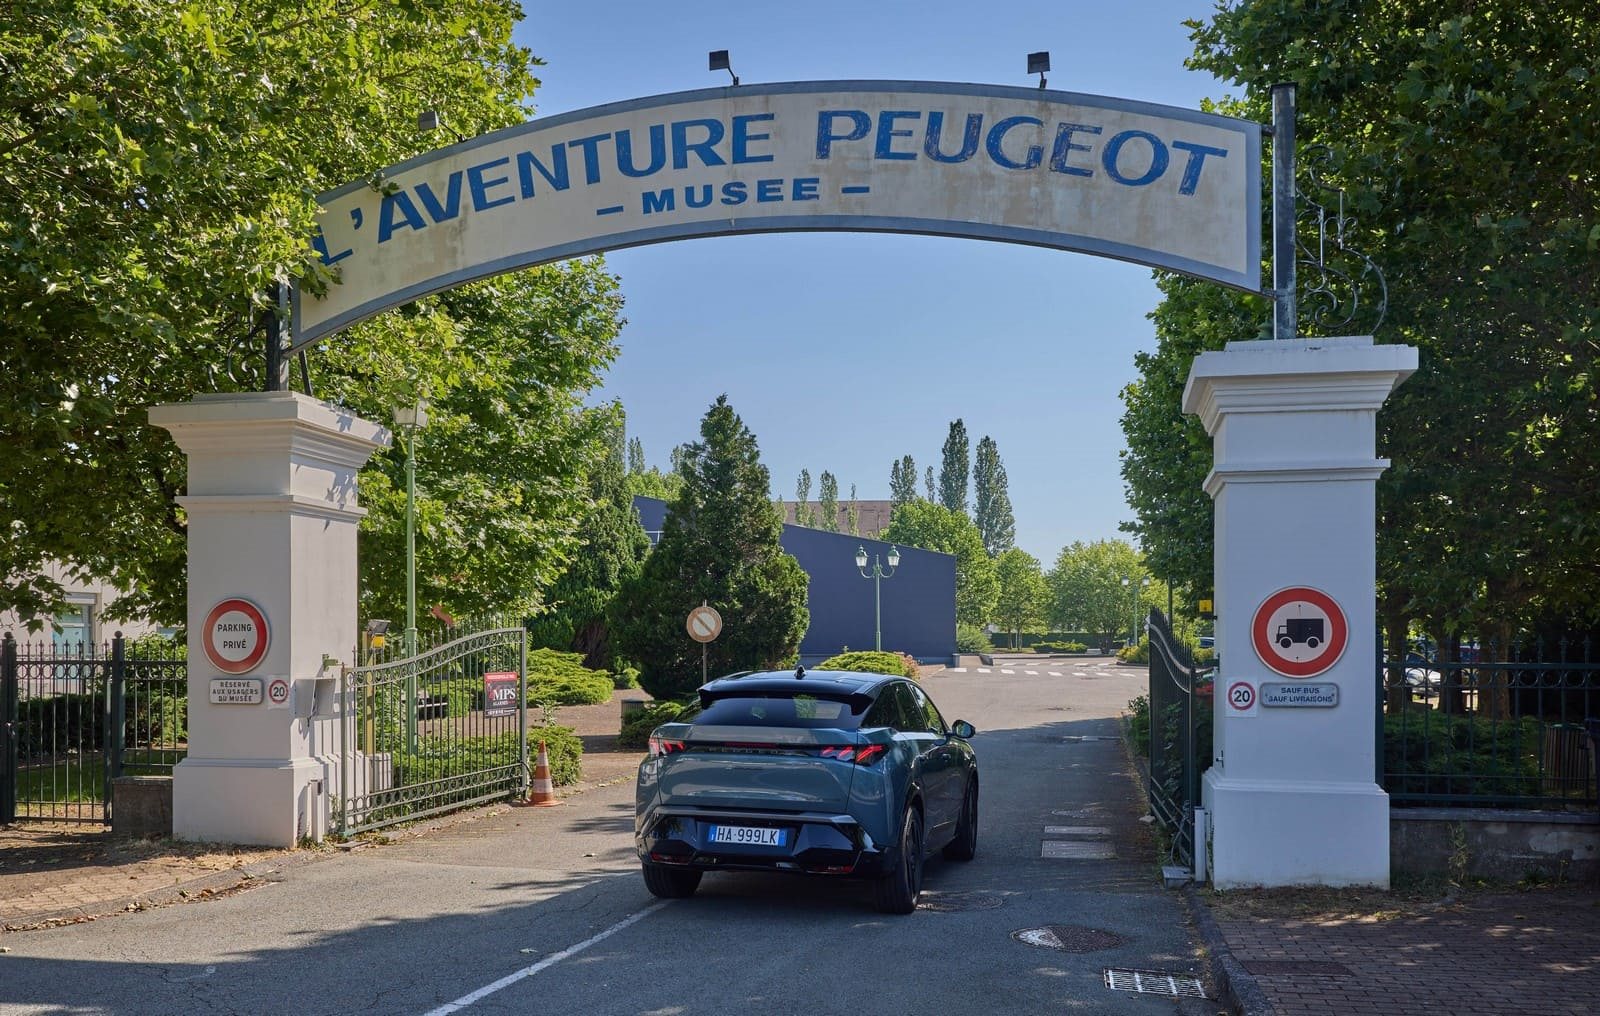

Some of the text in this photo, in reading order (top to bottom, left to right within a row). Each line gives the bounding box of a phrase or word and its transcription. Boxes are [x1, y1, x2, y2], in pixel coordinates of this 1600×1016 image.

[312, 109, 1228, 266] L'AVENTURE PEUGEOT
[642, 177, 820, 215] MUSEE
[217, 624, 252, 632] PARKING
[223, 639, 246, 648] PRIVÉ
[273, 687, 285, 697] 20
[493, 688, 515, 700] MPS
[1233, 690, 1251, 702] 20
